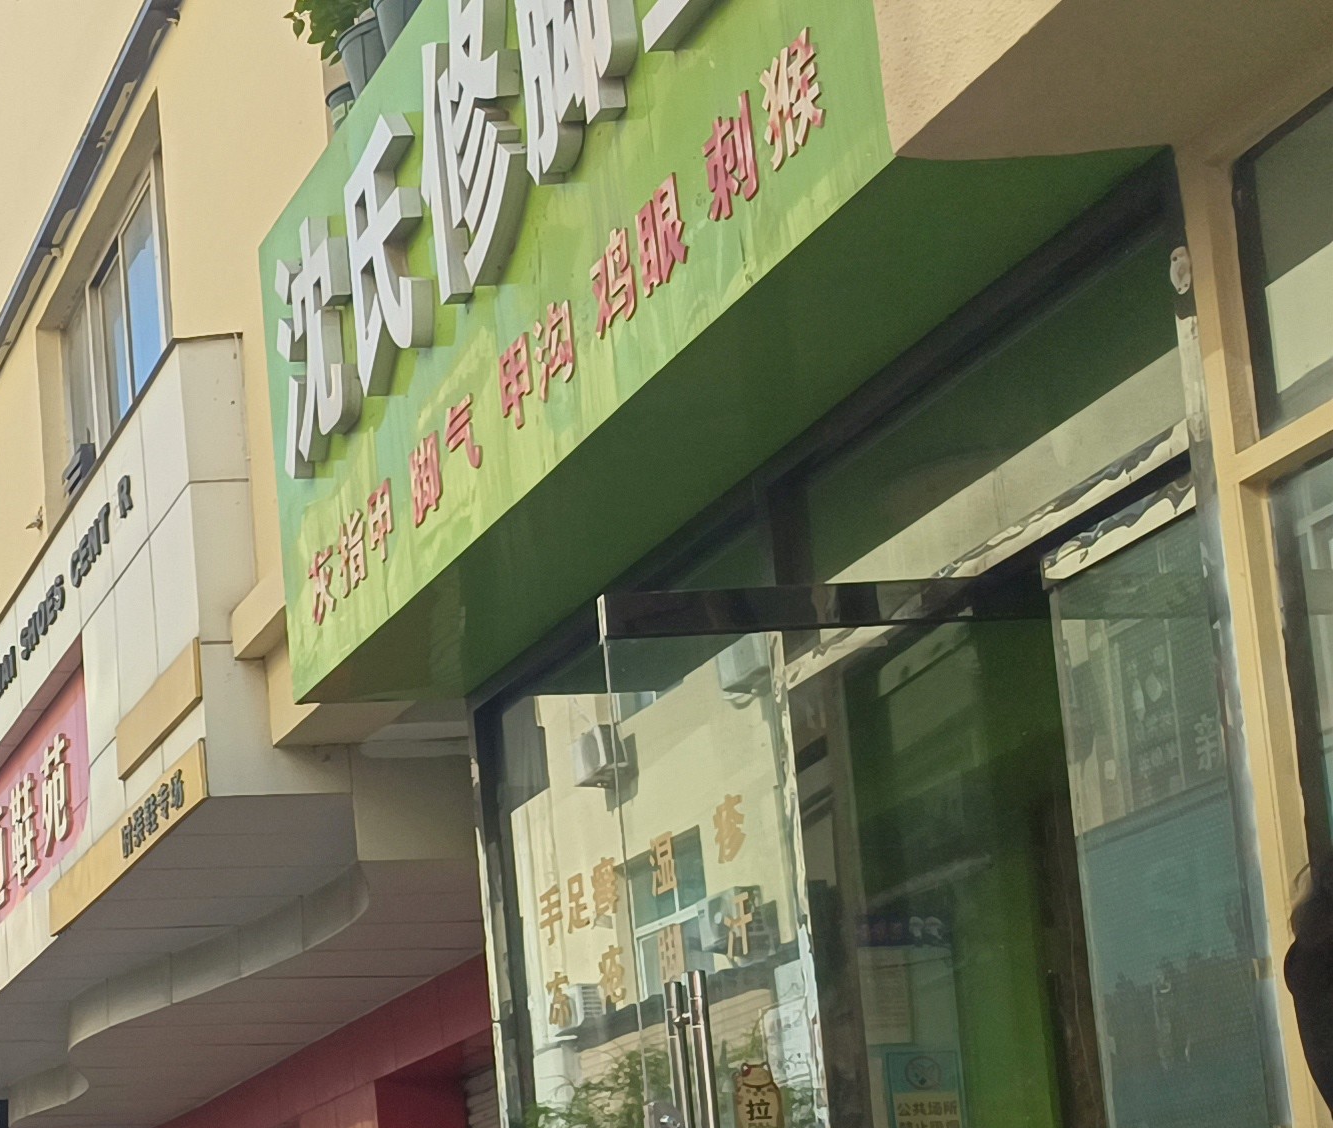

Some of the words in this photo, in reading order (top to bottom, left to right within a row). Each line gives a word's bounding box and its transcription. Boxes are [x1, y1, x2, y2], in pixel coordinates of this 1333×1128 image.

[275, 0, 728, 478] 沈氏修脚
[308, 478, 395, 626] 灰指甲
[408, 392, 484, 528] 脚气
[498, 299, 576, 428] 甲沟
[589, 171, 690, 340] 鸡眼
[701, 26, 827, 222] 刺猴
[19, 573, 66, 662] SHOES
[744, 1098, 773, 1121] 拉
